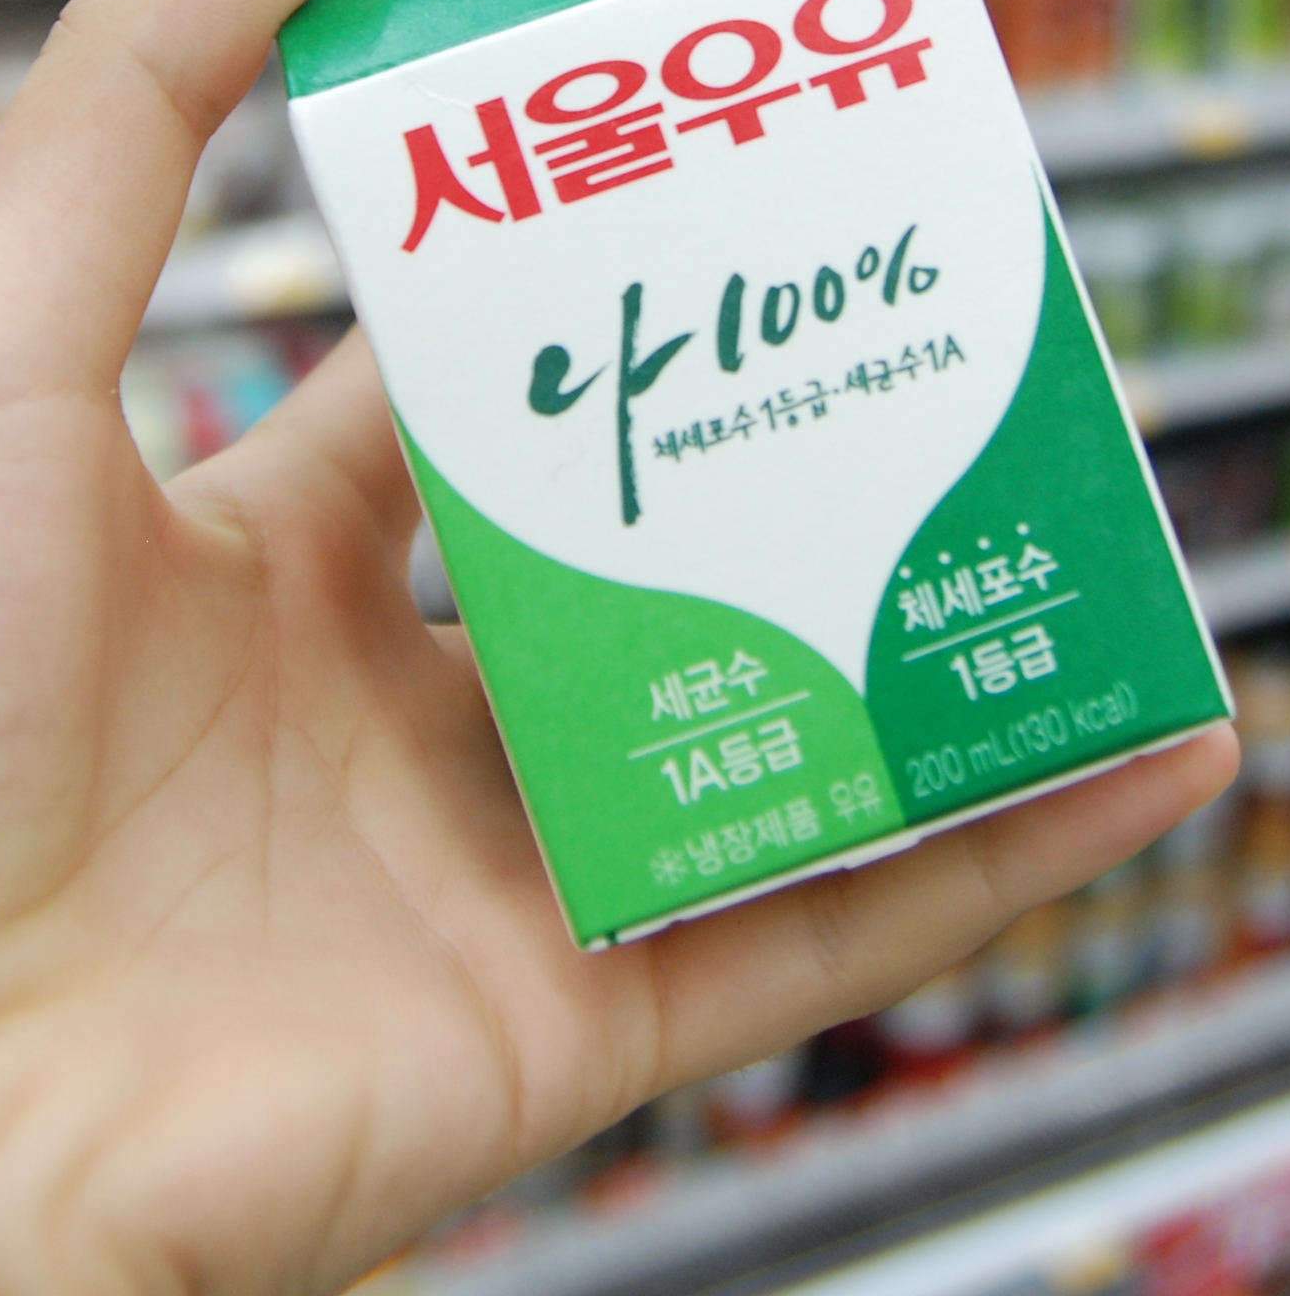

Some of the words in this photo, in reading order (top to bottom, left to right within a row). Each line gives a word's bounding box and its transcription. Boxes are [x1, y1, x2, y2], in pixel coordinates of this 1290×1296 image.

[527, 282, 697, 526] 나
[716, 223, 939, 373] 100%
[898, 542, 1059, 632] 체세포수
[650, 650, 769, 722] 세균수
[949, 623, 1058, 702] 1등급
[660, 717, 803, 806] 1A등급
[906, 742, 966, 799] 200
[685, 795, 821, 877] 냉장제품
[829, 773, 884, 826] 우유
